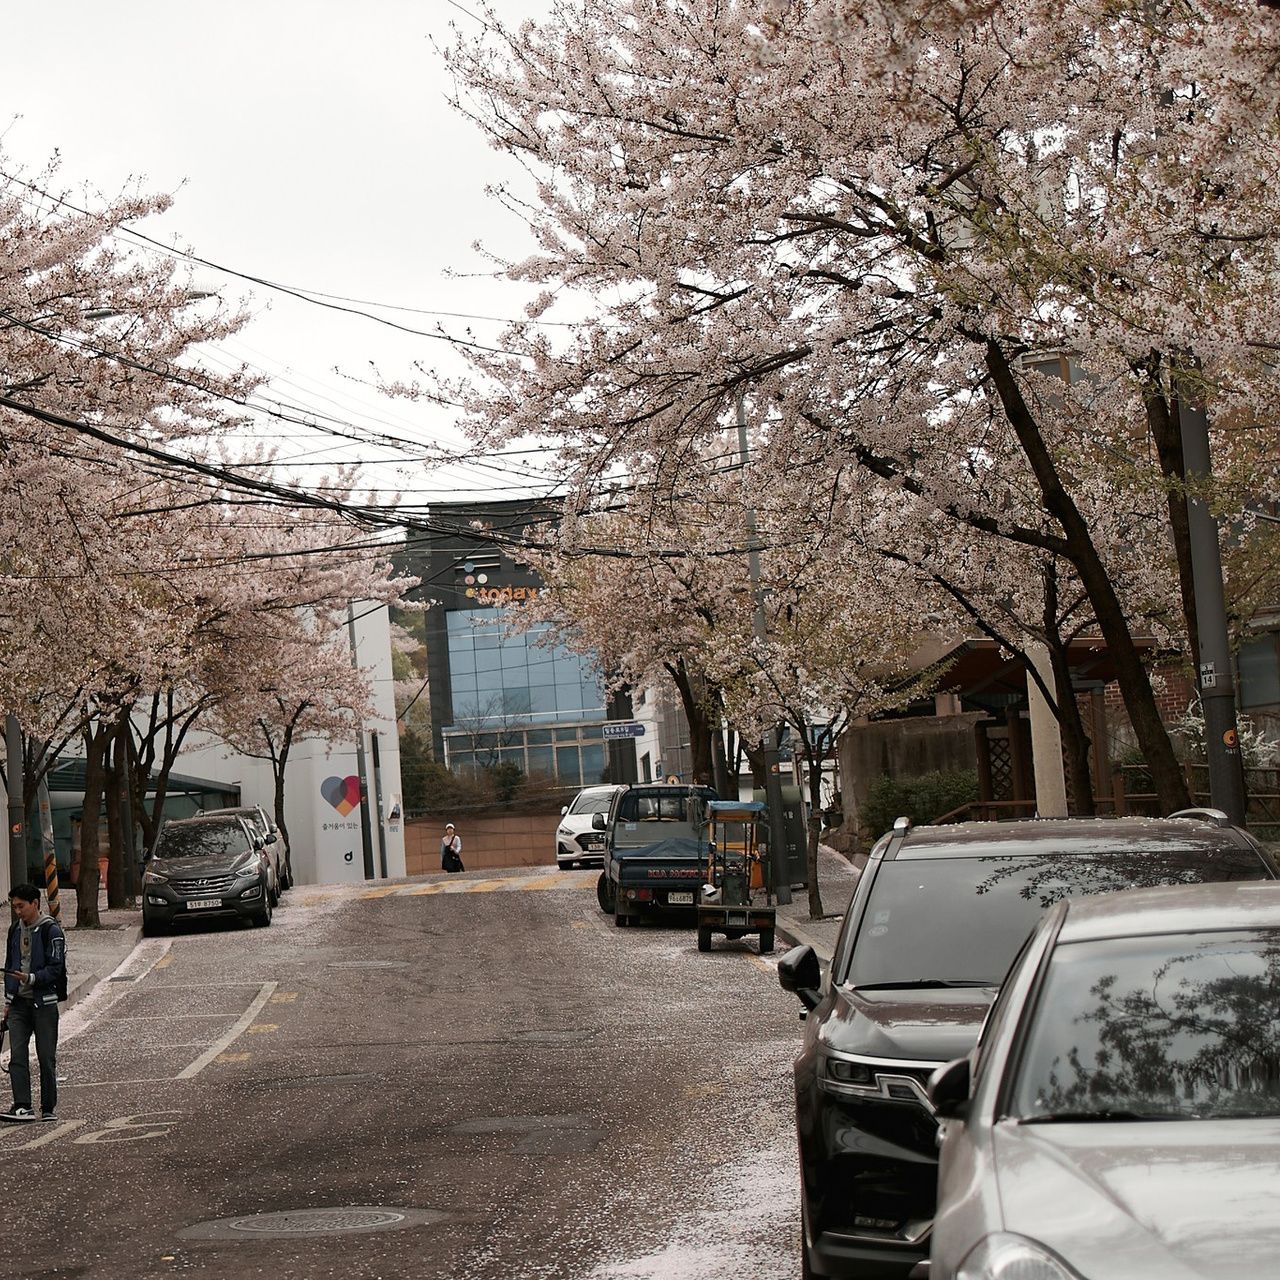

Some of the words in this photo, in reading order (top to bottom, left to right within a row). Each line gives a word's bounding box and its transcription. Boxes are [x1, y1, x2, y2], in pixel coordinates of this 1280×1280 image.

[1204, 675, 1213, 684] 14
[322, 823, 346, 831] 즐거움이
[346, 822, 358, 830] 있는
[648, 869, 668, 878] KIA
